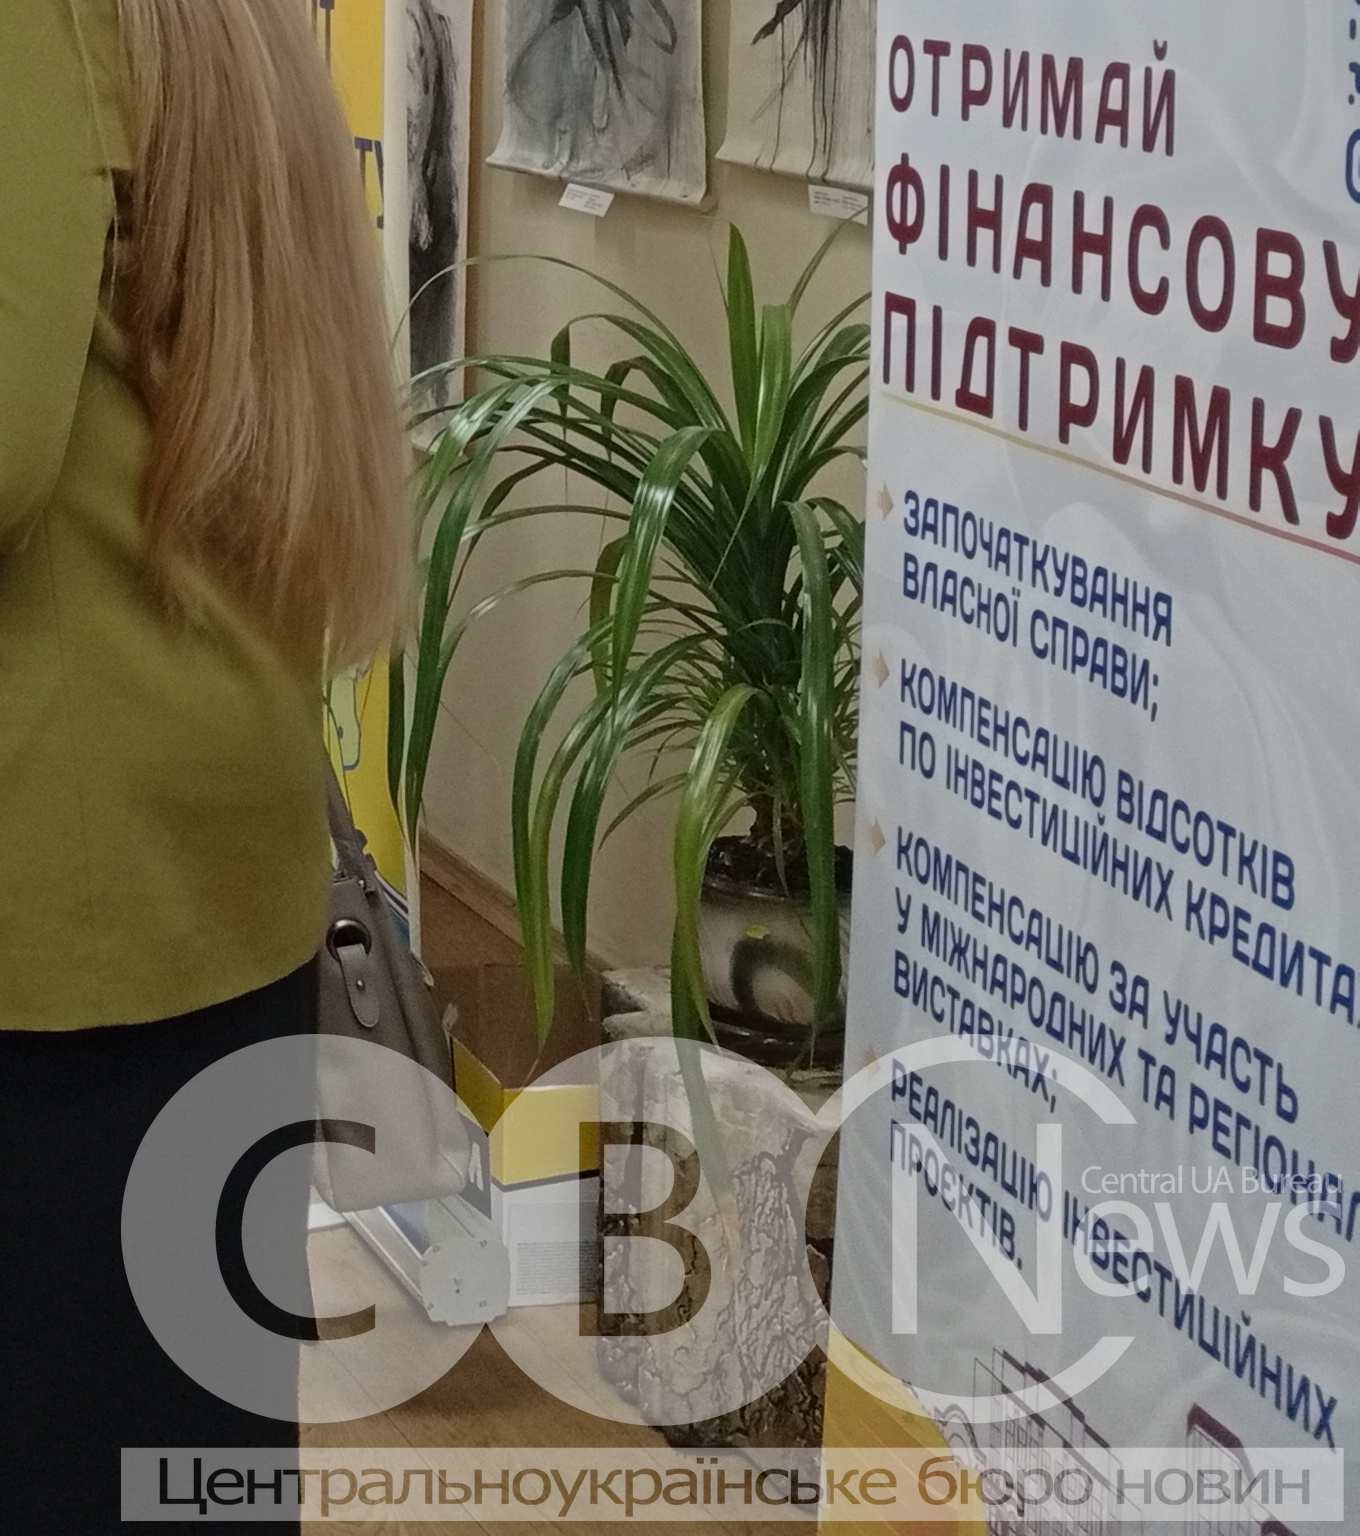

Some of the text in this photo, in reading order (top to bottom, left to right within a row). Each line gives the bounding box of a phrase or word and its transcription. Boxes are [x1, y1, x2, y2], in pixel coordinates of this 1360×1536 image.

[888, 34, 1176, 156] ОТРИМАЙ
[885, 152, 1360, 363] ФІНАНСОВУ
[883, 291, 1360, 540] ПІДТРИМКУ
[903, 490, 1173, 647] ЗАПОЧАТКУВАННЯ
[903, 552, 1159, 722] ВЛАСНОЇ СПРАВИ;
[899, 721, 1360, 1028] ПО ІНВЕСТИЦІЙНИХ КРЕДИТА
[900, 658, 1295, 911] КОМПЕНСАЦІЮ ВІДСОТКІВ
[894, 950, 1058, 1113] ВИСТАВКАХ;
[895, 886, 912, 934] У
[921, 904, 1126, 1087] МІЖНАРОДНИХ
[1137, 1049, 1176, 1120] ТА
[896, 826, 1299, 1124] КОМПЕНСАЦІЮ ЗА УЧАСТЬ
[892, 1059, 1338, 1452] РЕАЛІЗАЦІЮ ІНВЕСТИЦІЙНИХ
